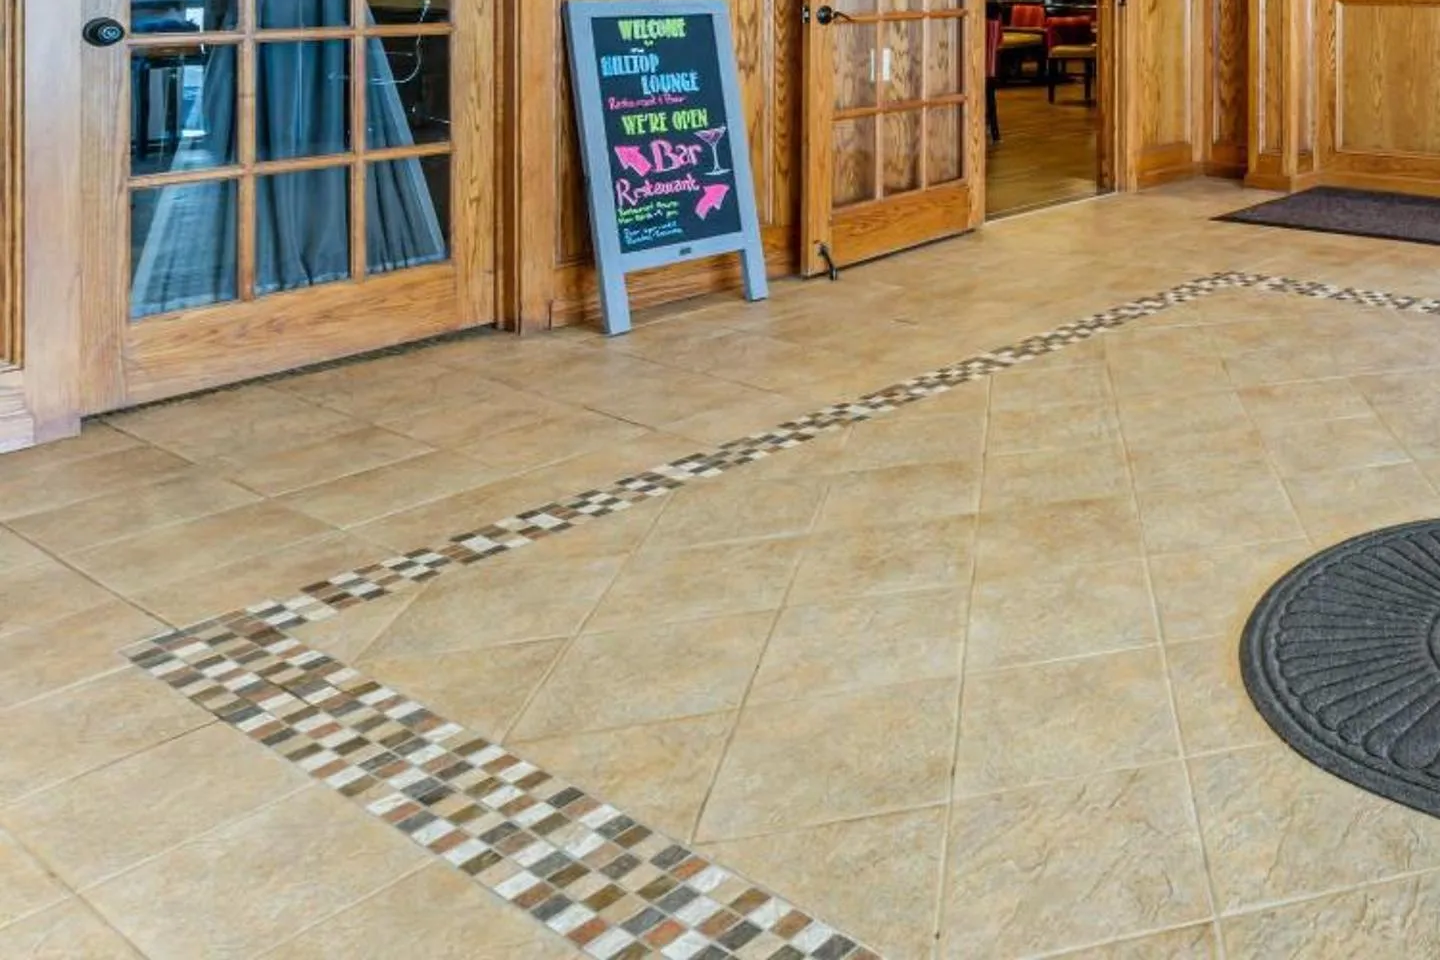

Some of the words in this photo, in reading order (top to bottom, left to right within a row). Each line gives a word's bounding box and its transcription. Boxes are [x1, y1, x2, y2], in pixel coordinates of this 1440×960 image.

[618, 18, 686, 40] WELCOME
[641, 70, 700, 95] LOUNGE
[621, 112, 668, 136] WE'RE
[672, 108, 708, 131] OPEN
[649, 139, 702, 172] Bar
